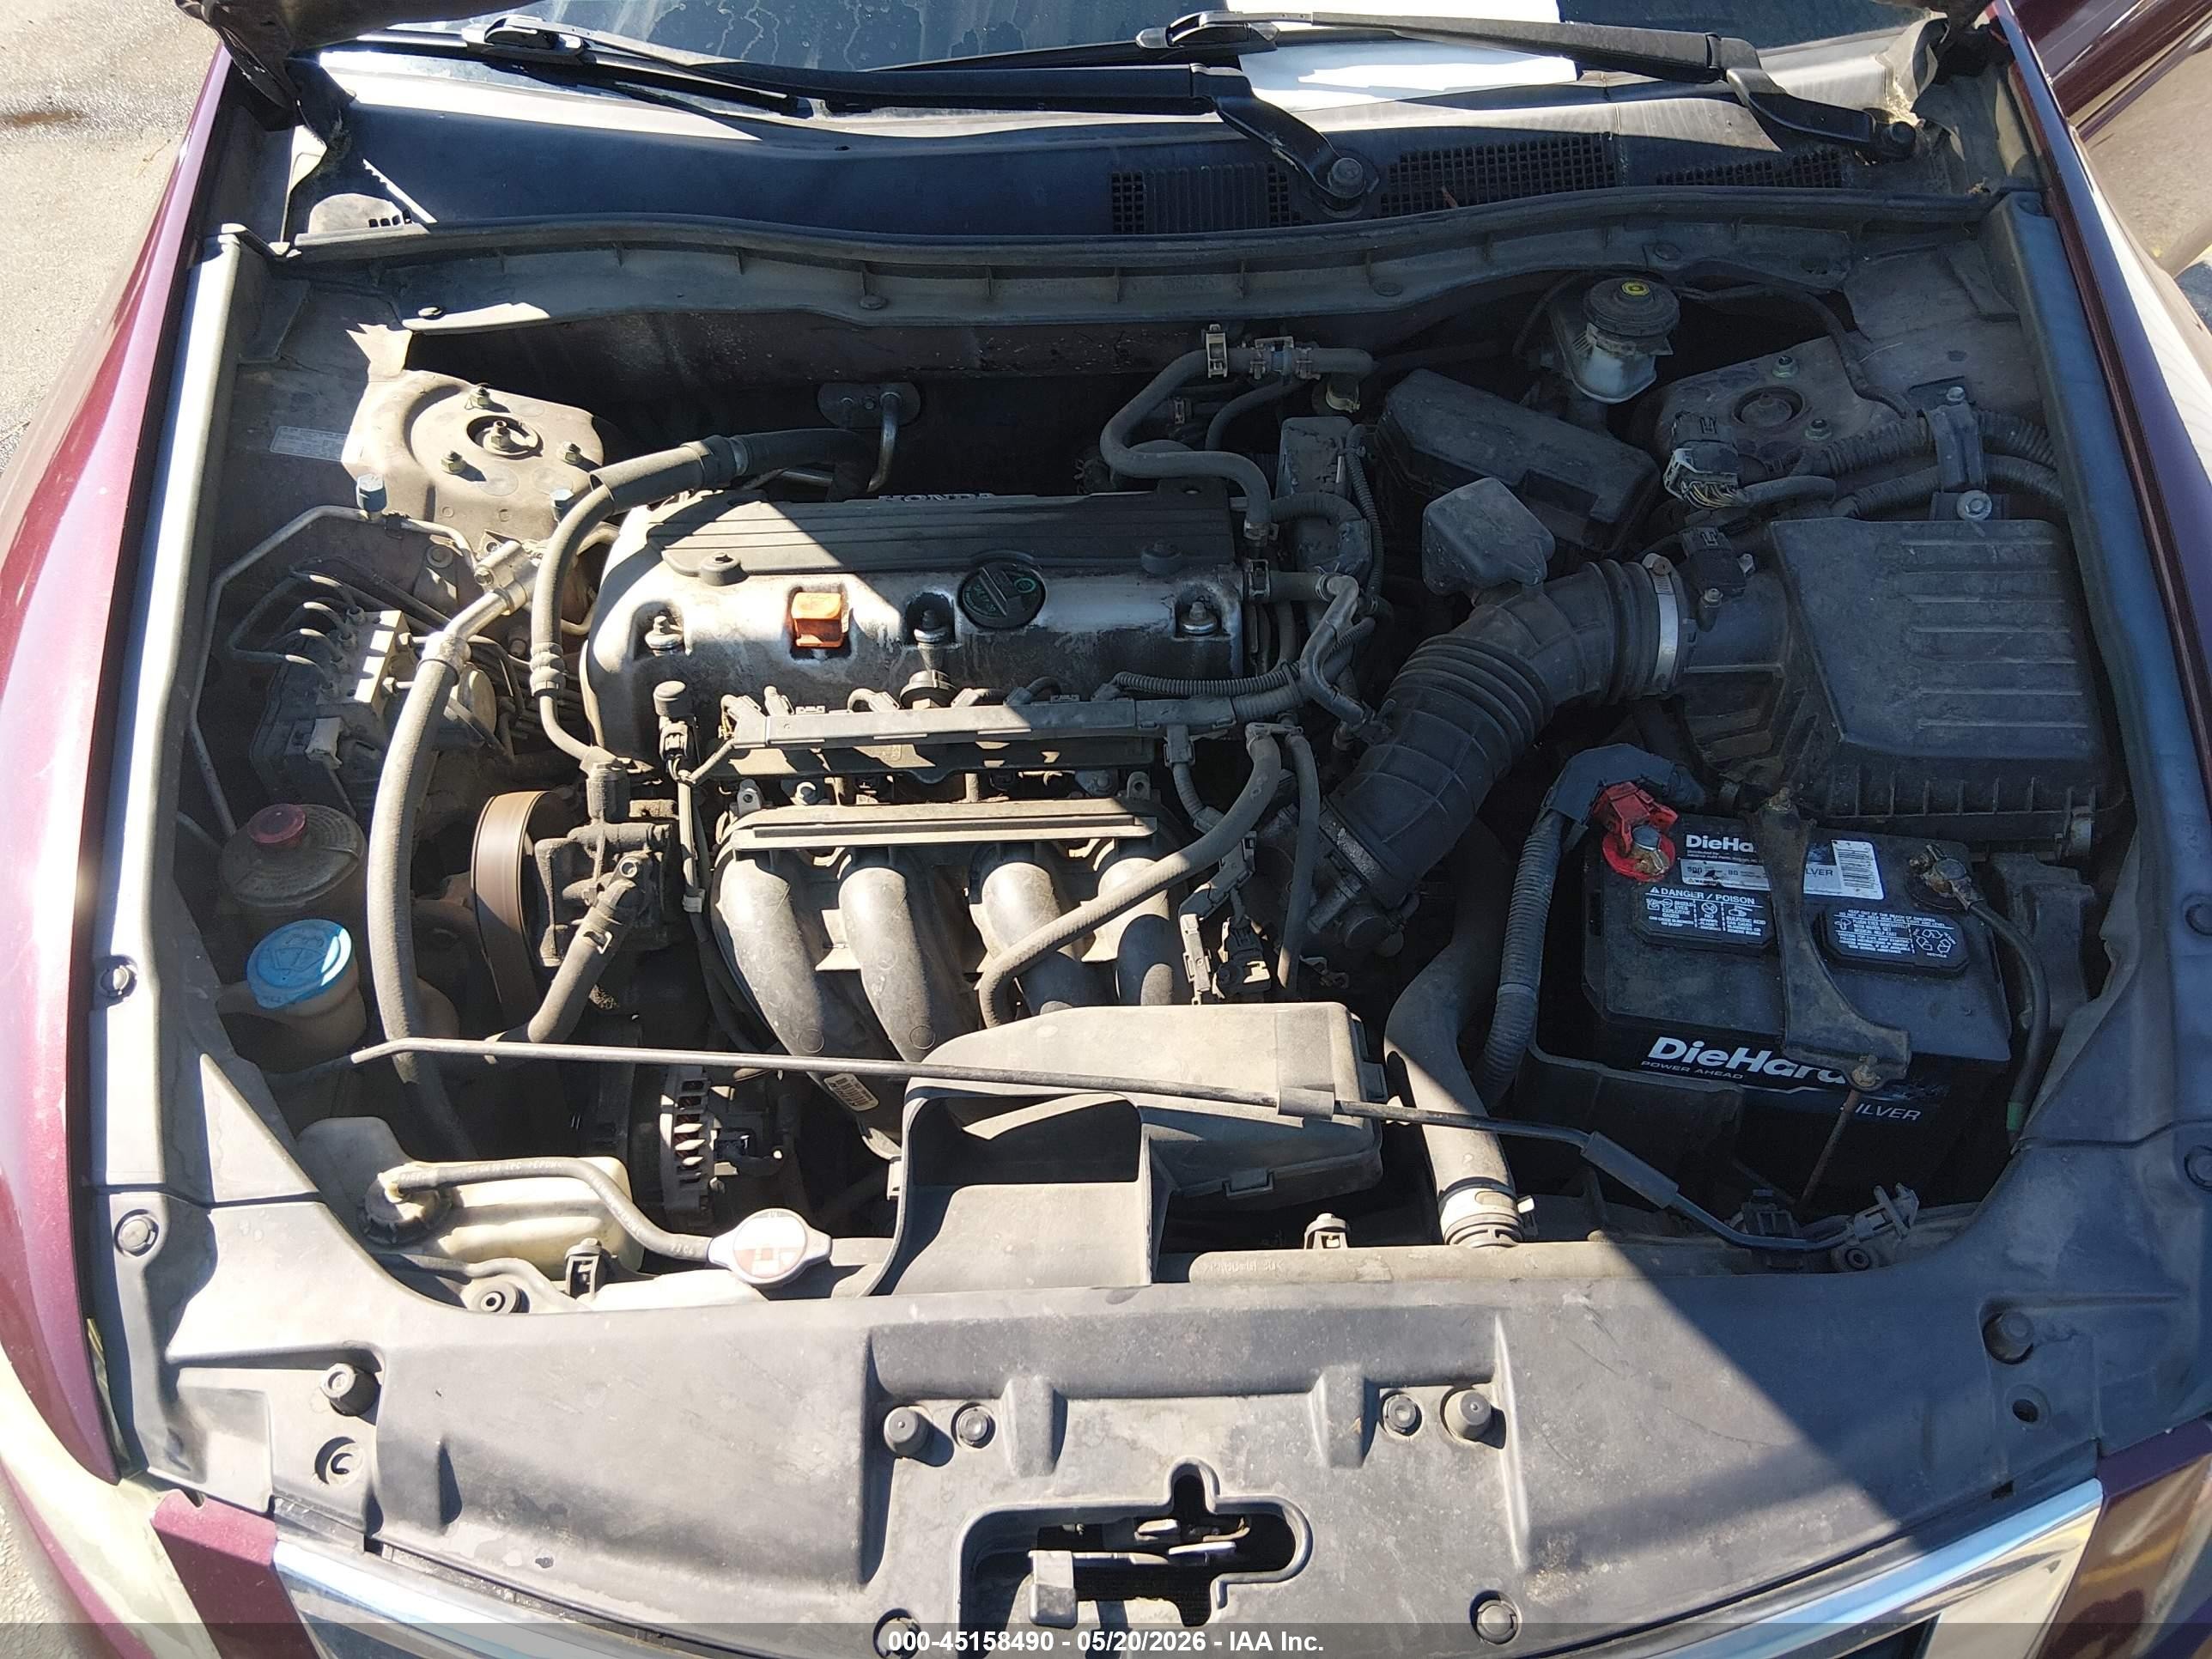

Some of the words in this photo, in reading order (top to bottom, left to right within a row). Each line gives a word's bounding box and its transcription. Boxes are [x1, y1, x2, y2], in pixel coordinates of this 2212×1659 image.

[1686, 834, 1757, 853] DieHa
[1661, 887, 1705, 900] DANGER
[1715, 894, 1755, 905] POISON
[1641, 1060, 1691, 1073] POWER
[1693, 1068, 1744, 1079] AHEAD
[1839, 1103, 1922, 1121] ILVER
